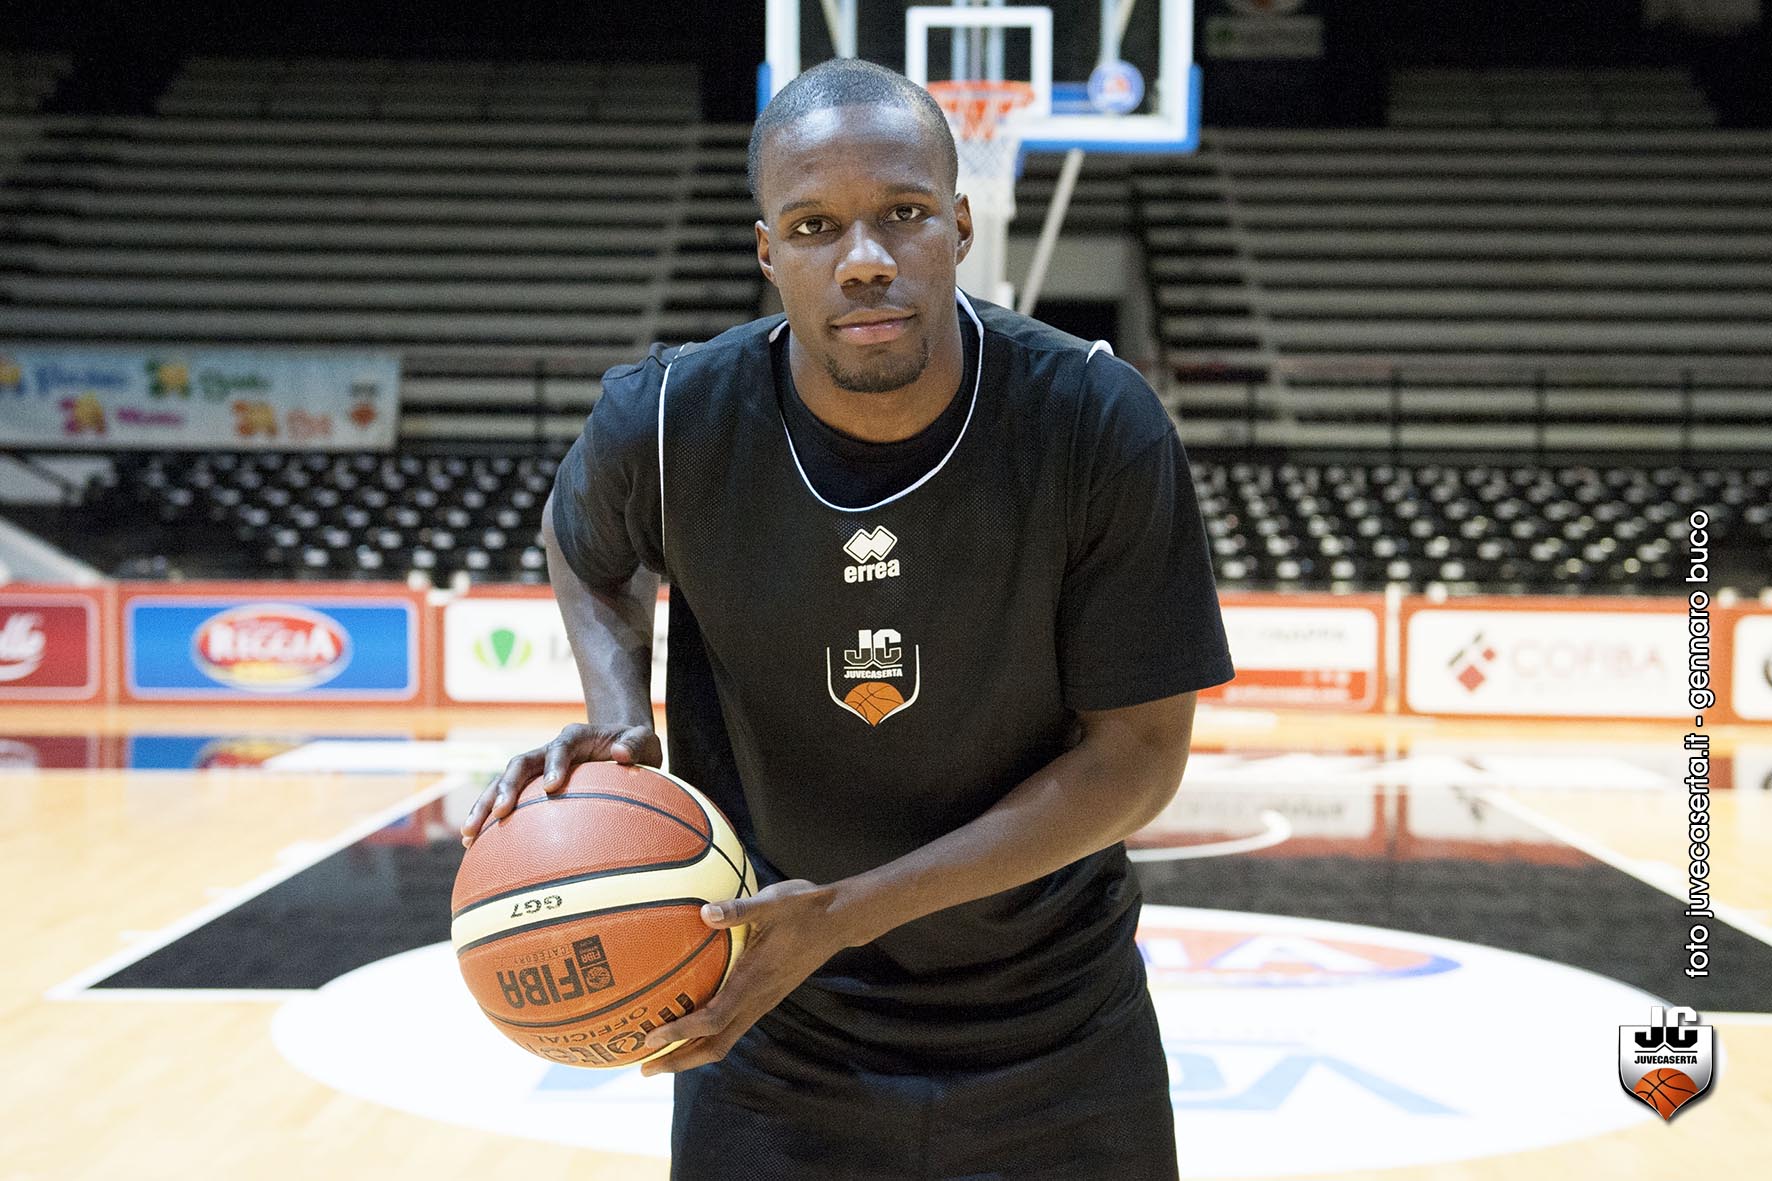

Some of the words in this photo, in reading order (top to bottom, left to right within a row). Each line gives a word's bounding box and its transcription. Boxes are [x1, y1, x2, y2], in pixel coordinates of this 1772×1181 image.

[844, 559, 900, 583] errea
[844, 628, 902, 665] JC
[844, 668, 903, 679] JUVECASERTA
[510, 895, 563, 918] GG7
[496, 957, 585, 1009] FIBA
[537, 1006, 648, 1043] OFFICIAL
